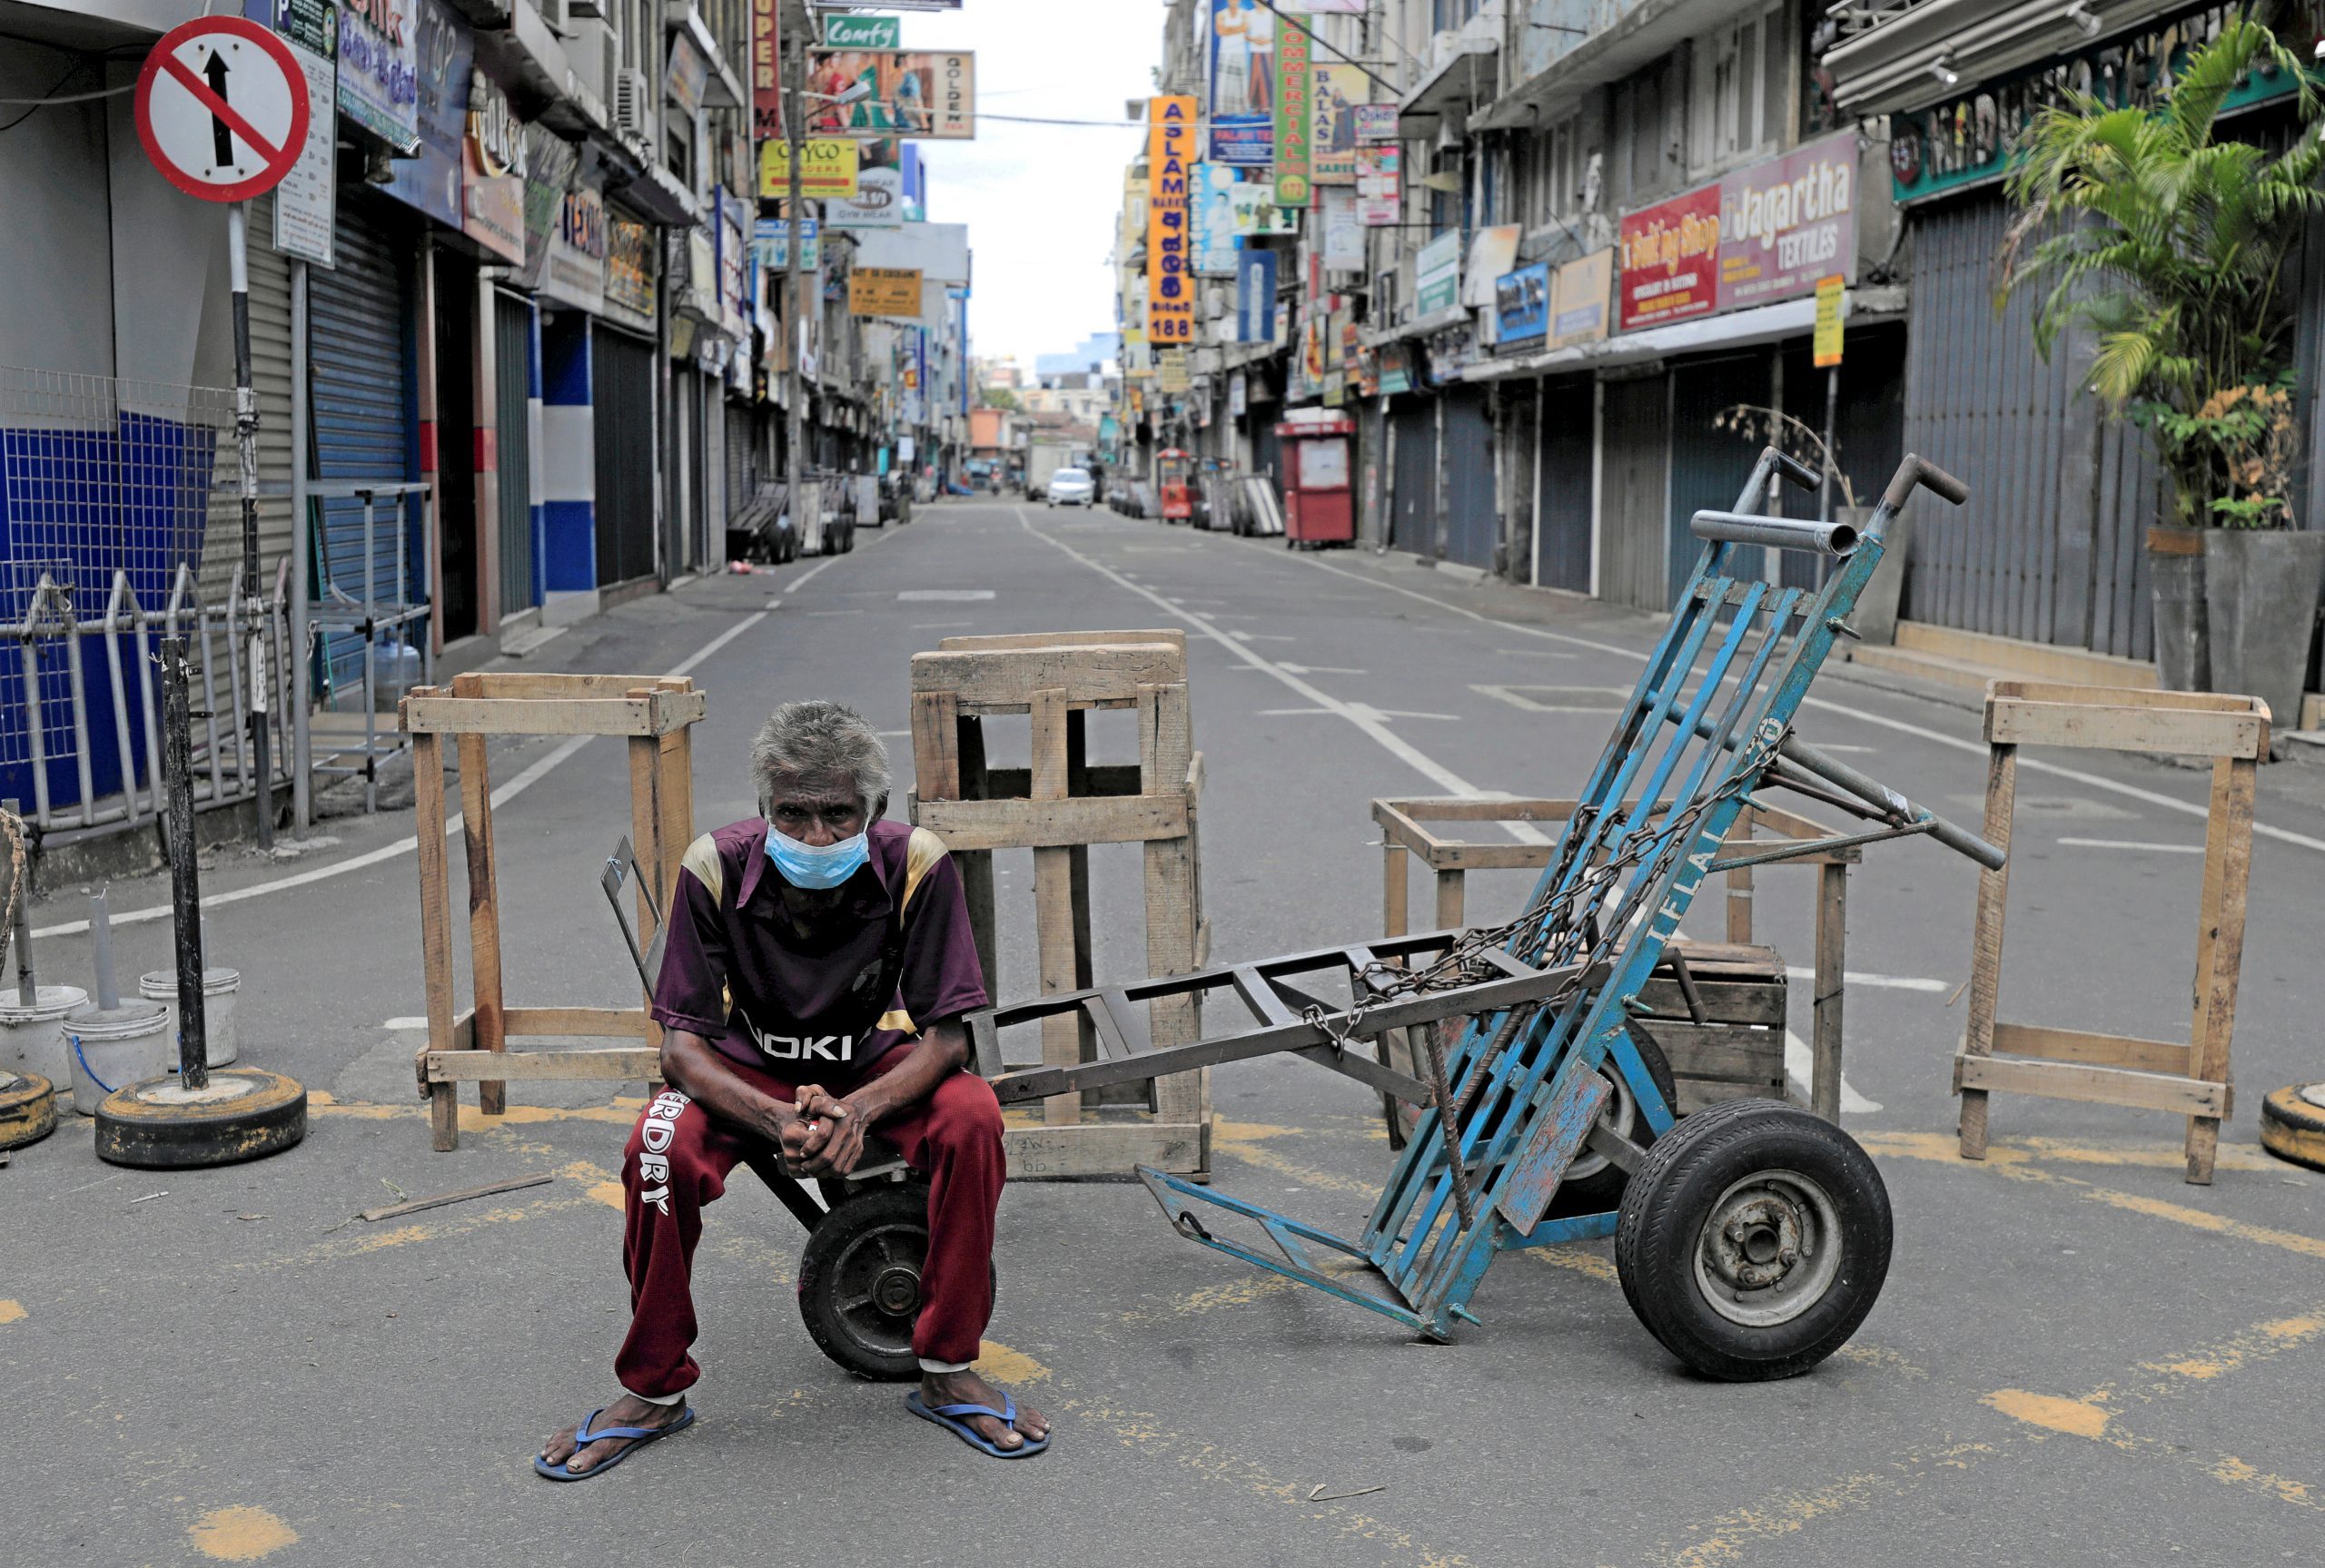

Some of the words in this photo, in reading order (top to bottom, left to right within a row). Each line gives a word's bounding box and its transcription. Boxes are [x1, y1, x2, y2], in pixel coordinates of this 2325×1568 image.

[828, 20, 895, 45] Comfy
[1281, 16, 1307, 159] COMMERCIAL
[1315, 70, 1331, 140] BALAS
[777, 143, 839, 163] CYCO
[780, 164, 843, 173] TADERS
[1163, 103, 1184, 193] ASLAM
[1734, 161, 1850, 251] Jagartha
[1777, 223, 1838, 271] TEXTILES
[1152, 320, 1189, 337] 188
[740, 1009, 870, 1060] NOKI
